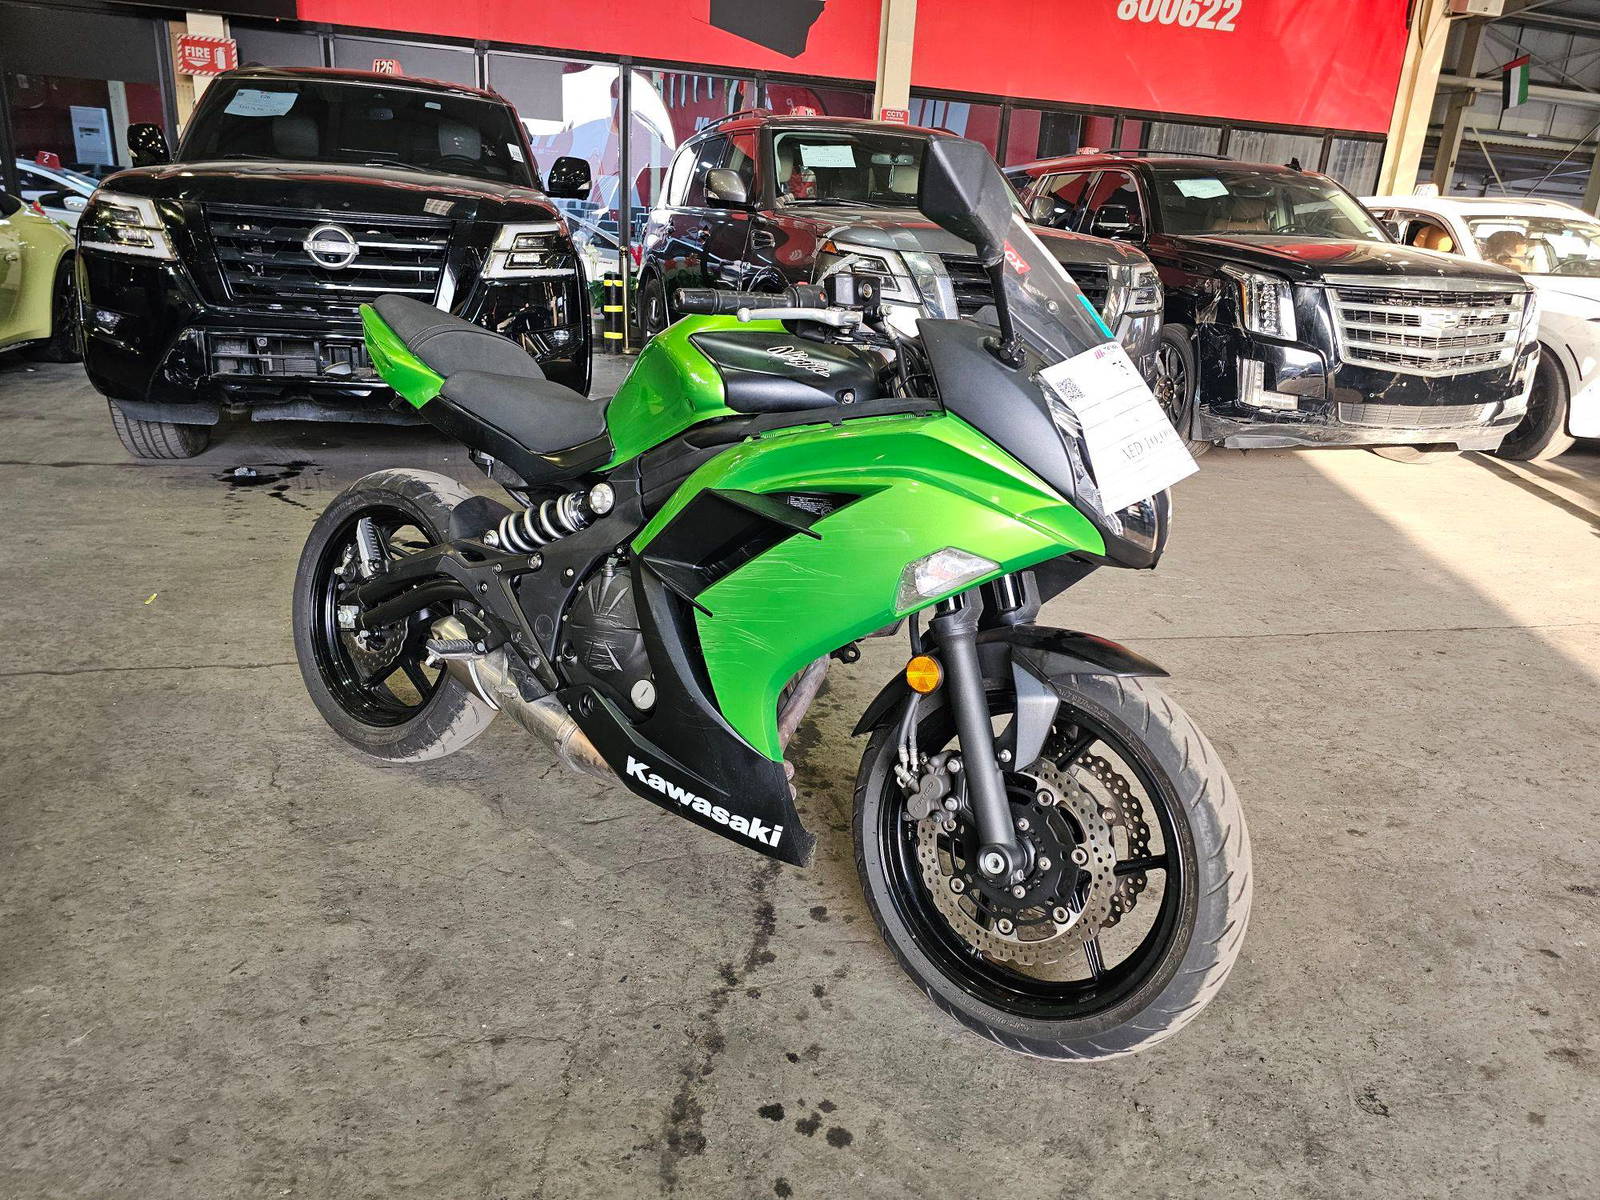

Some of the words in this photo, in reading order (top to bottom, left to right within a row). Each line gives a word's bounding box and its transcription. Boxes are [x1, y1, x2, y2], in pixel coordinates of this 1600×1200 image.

[1117, 0, 1242, 32] 800622
[185, 46, 211, 58] FIRE
[375, 60, 394, 73] 126
[886, 110, 905, 118] CCTV
[303, 240, 360, 255] NISSAN
[766, 345, 832, 378] Ninja
[625, 754, 784, 848] Kawasaki
